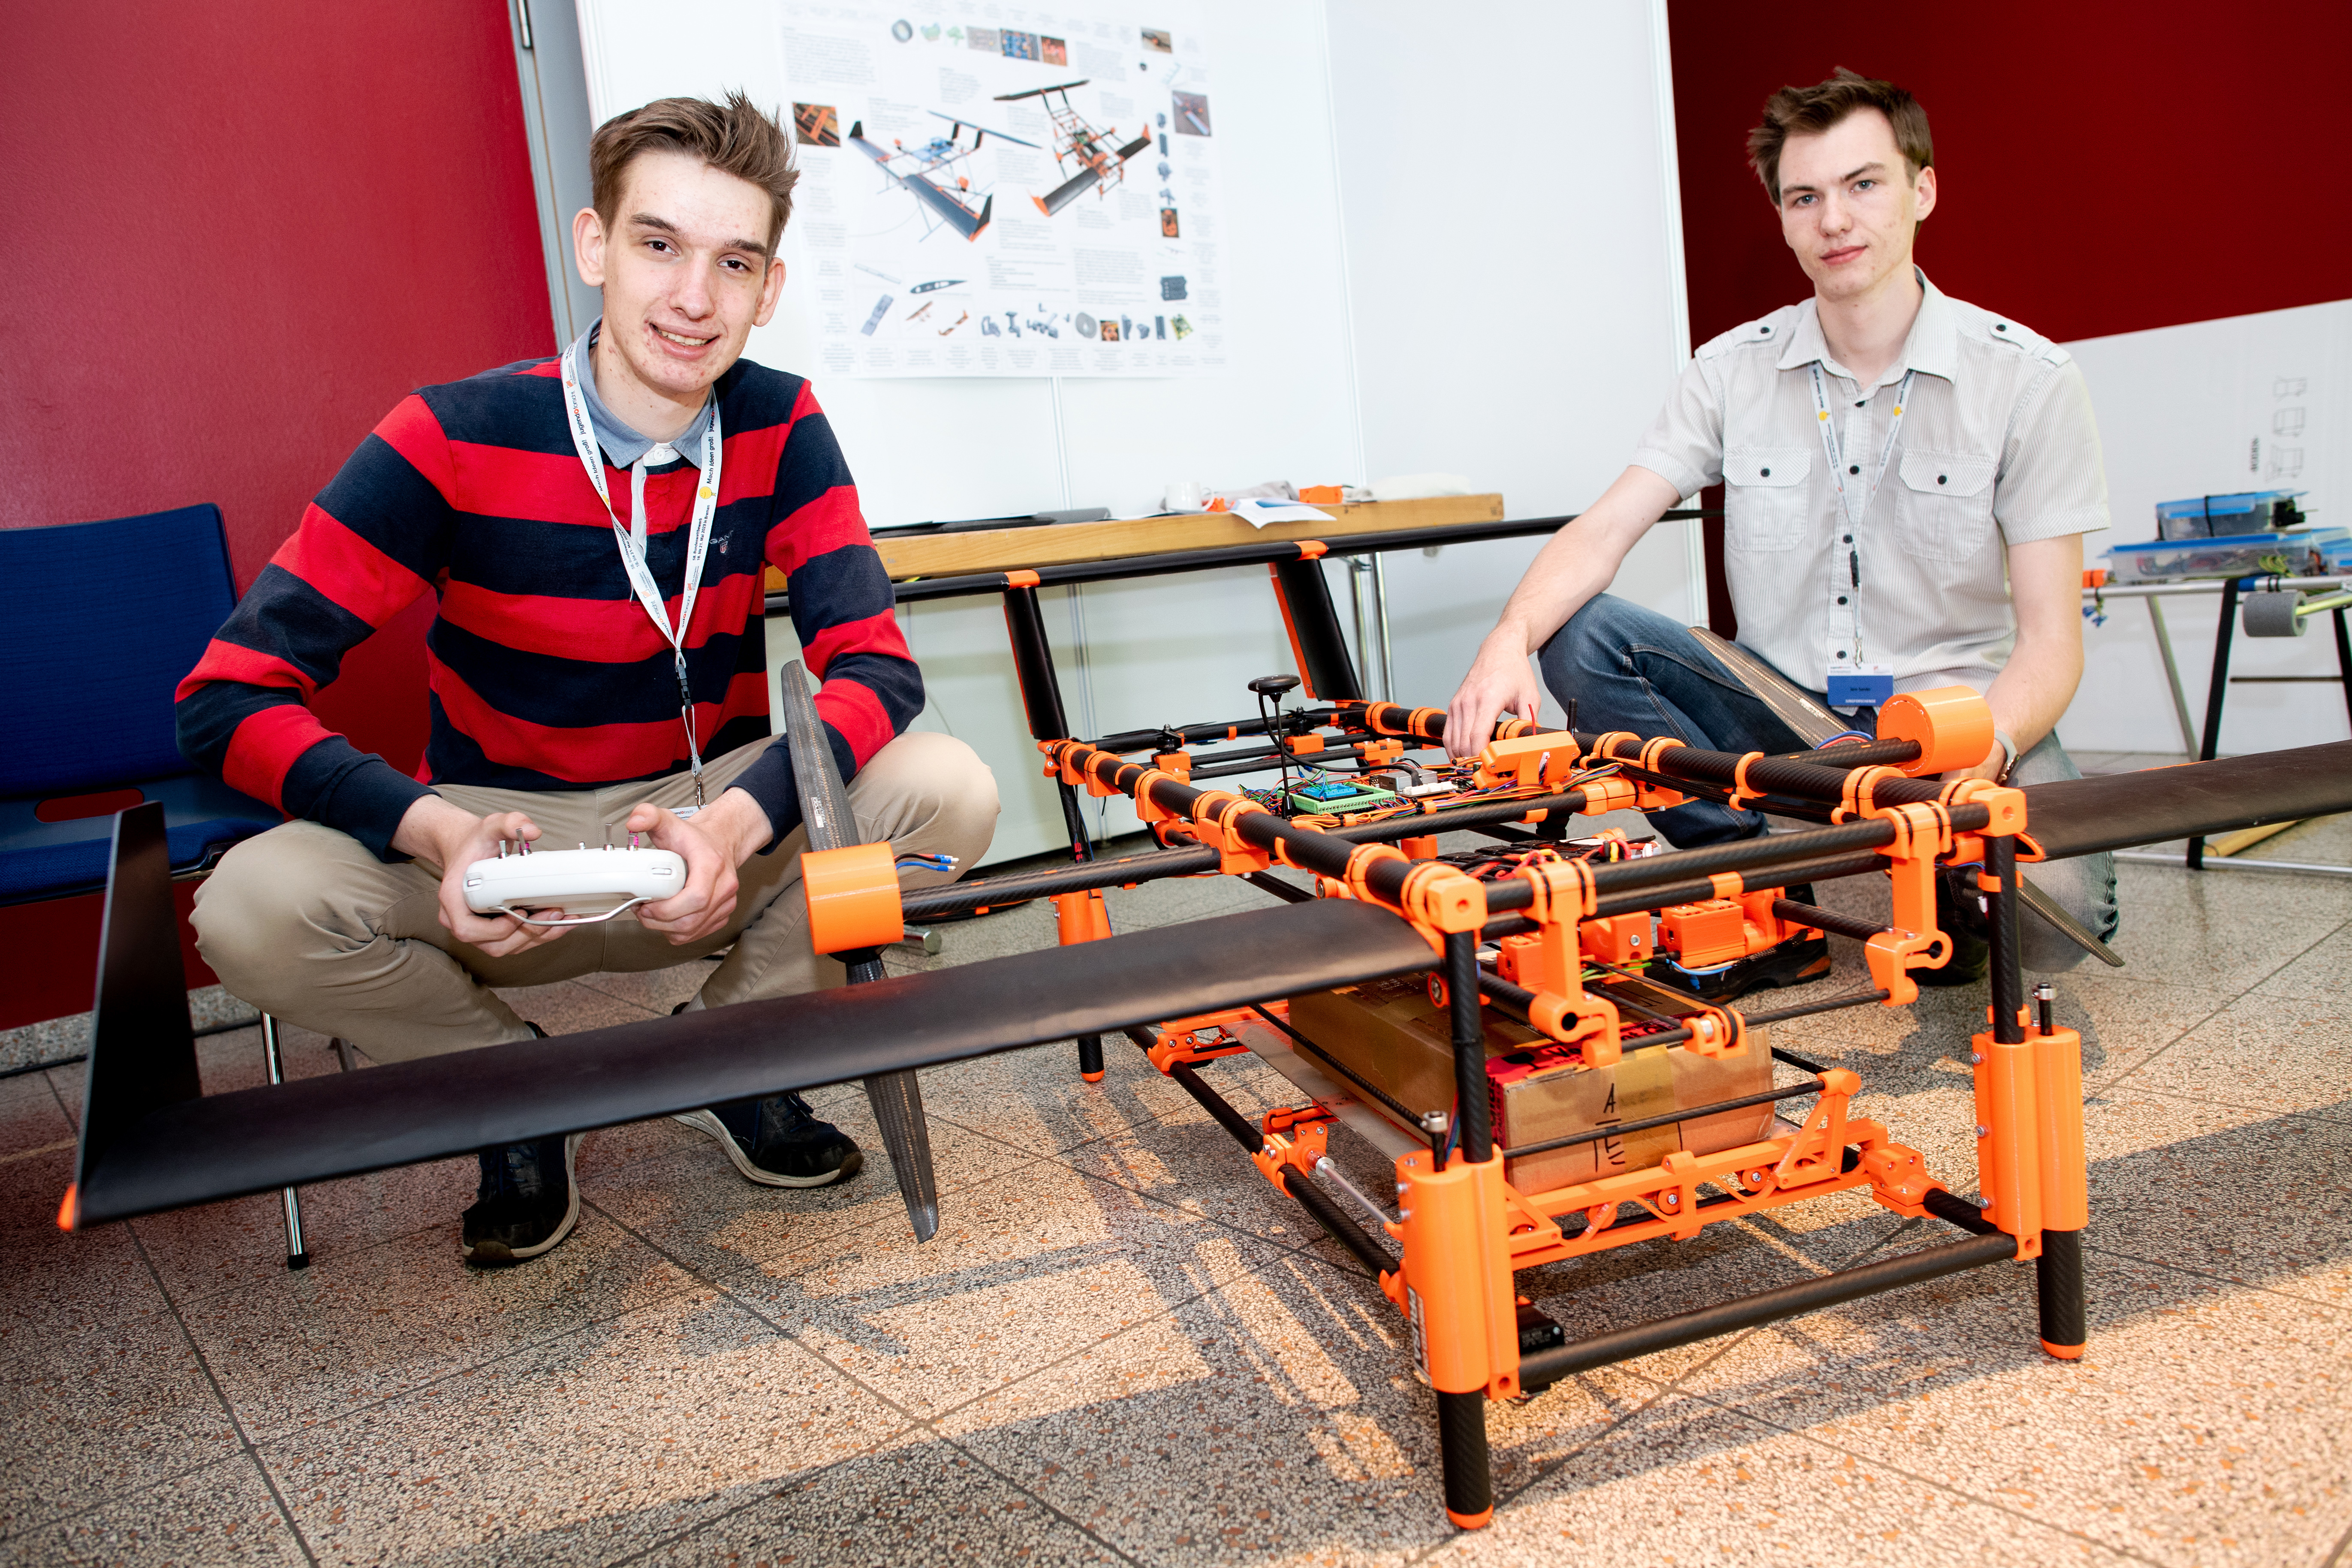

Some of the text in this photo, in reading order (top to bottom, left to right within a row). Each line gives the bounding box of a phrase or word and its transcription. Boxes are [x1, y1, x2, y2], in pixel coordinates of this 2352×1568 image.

[575, 413, 586, 435] jugend
[581, 439, 593, 455] groß!
[589, 456, 598, 473] Ideen
[693, 518, 702, 554] Bundeswettbewerb
[709, 530, 734, 544] GANT
[650, 600, 661, 618] forscht
[1603, 1083, 1616, 1113] A
